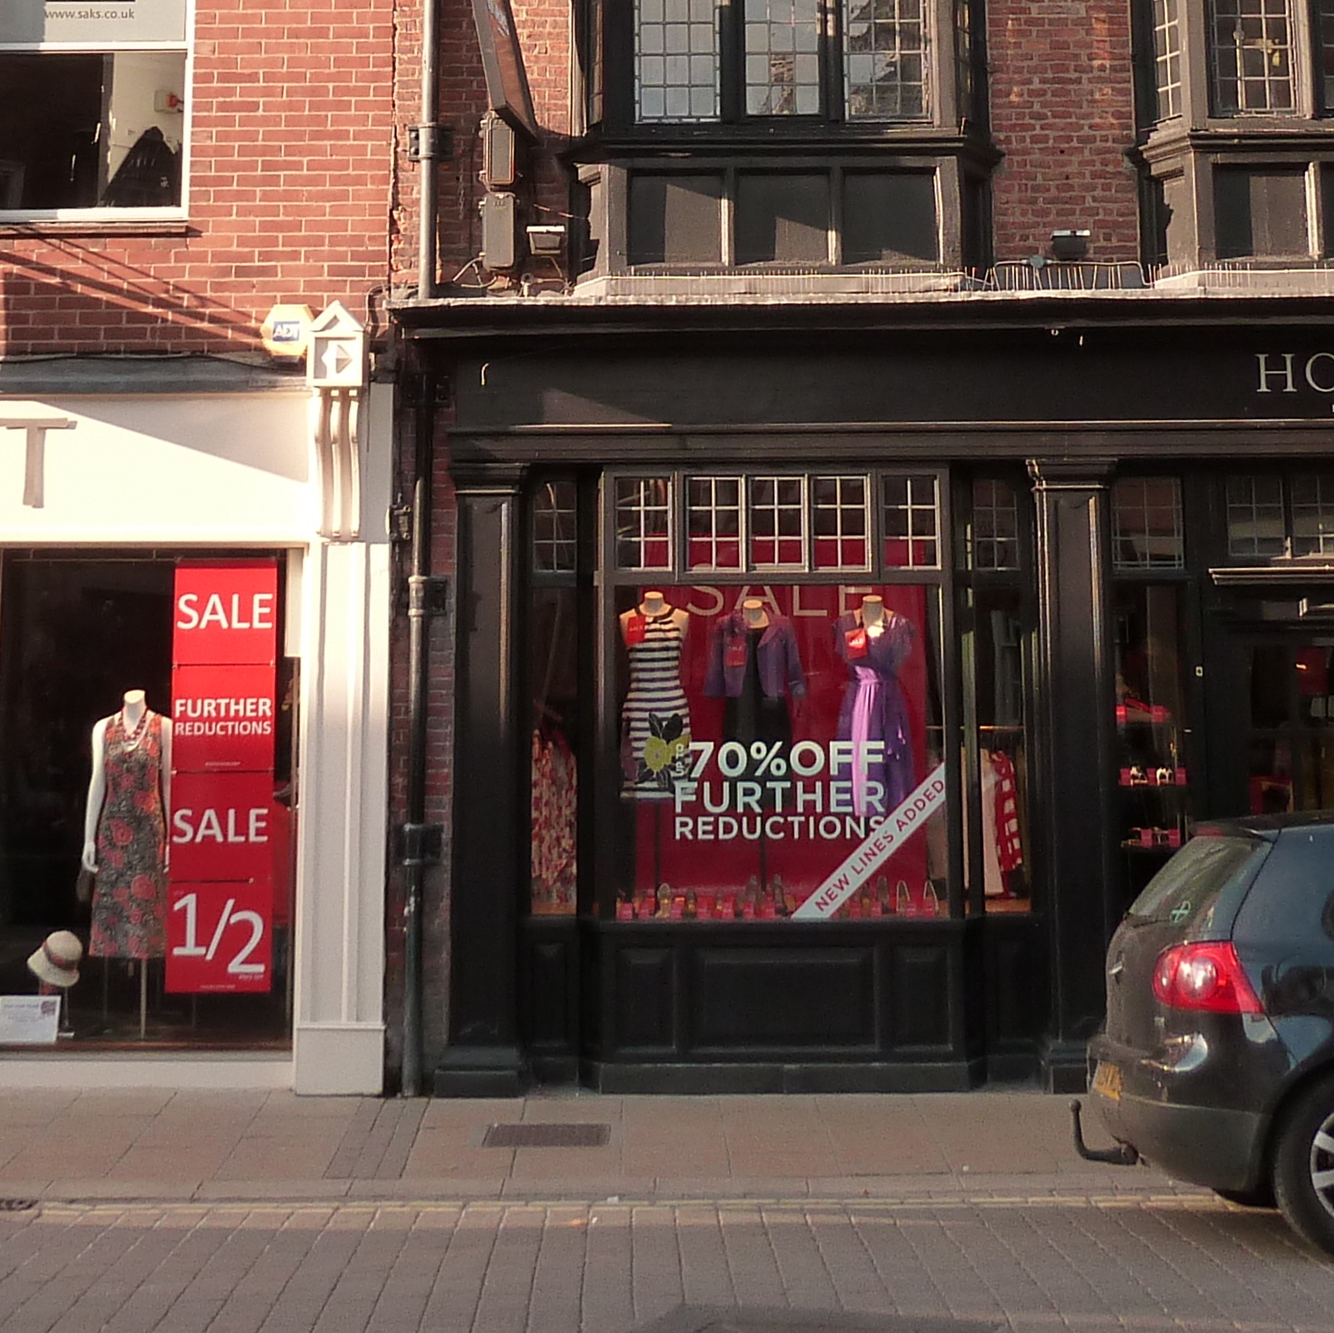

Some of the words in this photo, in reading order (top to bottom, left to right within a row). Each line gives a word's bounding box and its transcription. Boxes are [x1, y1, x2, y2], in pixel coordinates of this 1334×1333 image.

[44, 8, 135, 19] www.saks.co.uk
[176, 593, 273, 630] SALE
[175, 698, 272, 718] FURTHER
[175, 721, 272, 736] REDUCTIONS
[674, 780, 886, 814] FURTHER
[172, 807, 269, 844] SALE
[675, 816, 884, 840] REDUCTIONS
[814, 872, 850, 912] NEW
[851, 831, 895, 876] LINES
[895, 778, 945, 833] ADDED
[172, 892, 266, 974] 1/2
